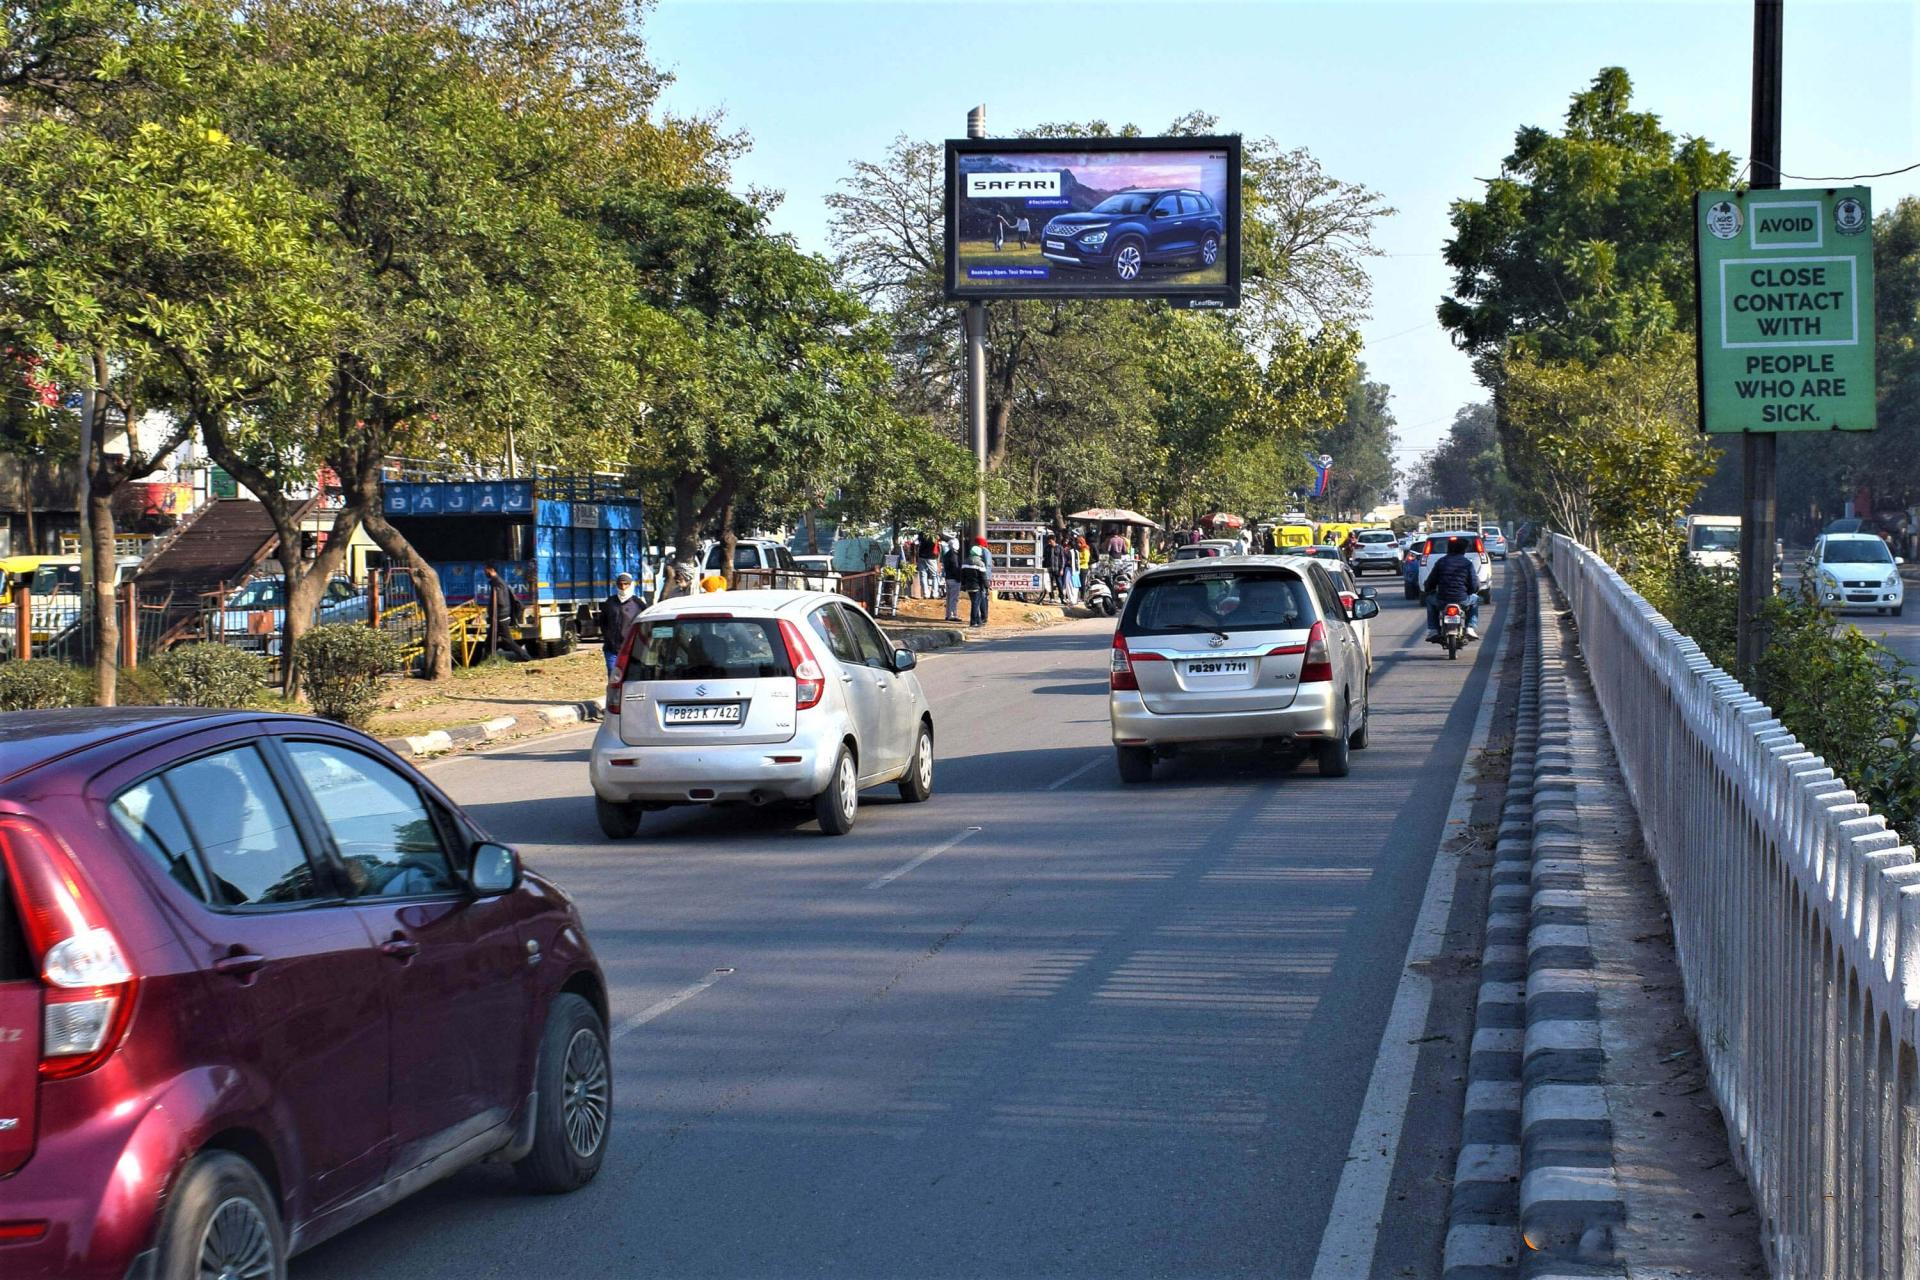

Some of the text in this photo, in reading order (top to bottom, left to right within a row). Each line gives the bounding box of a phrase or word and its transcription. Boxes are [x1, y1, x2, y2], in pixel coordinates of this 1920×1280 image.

[974, 181, 1055, 190] SAFARI
[1759, 217, 1814, 233] AVOID
[1750, 268, 1826, 287] CLOSE
[1733, 291, 1844, 312] CONTACT
[1757, 317, 1821, 336] WITH
[1746, 354, 1834, 374] PEOPLE
[1735, 378, 1846, 399] WHO ARE
[1762, 404, 1820, 423] SICK.
[391, 496, 523, 509] BAJAJ
[1188, 662, 1247, 673] PB29V 7711
[673, 707, 738, 719] PB23 K 7422
